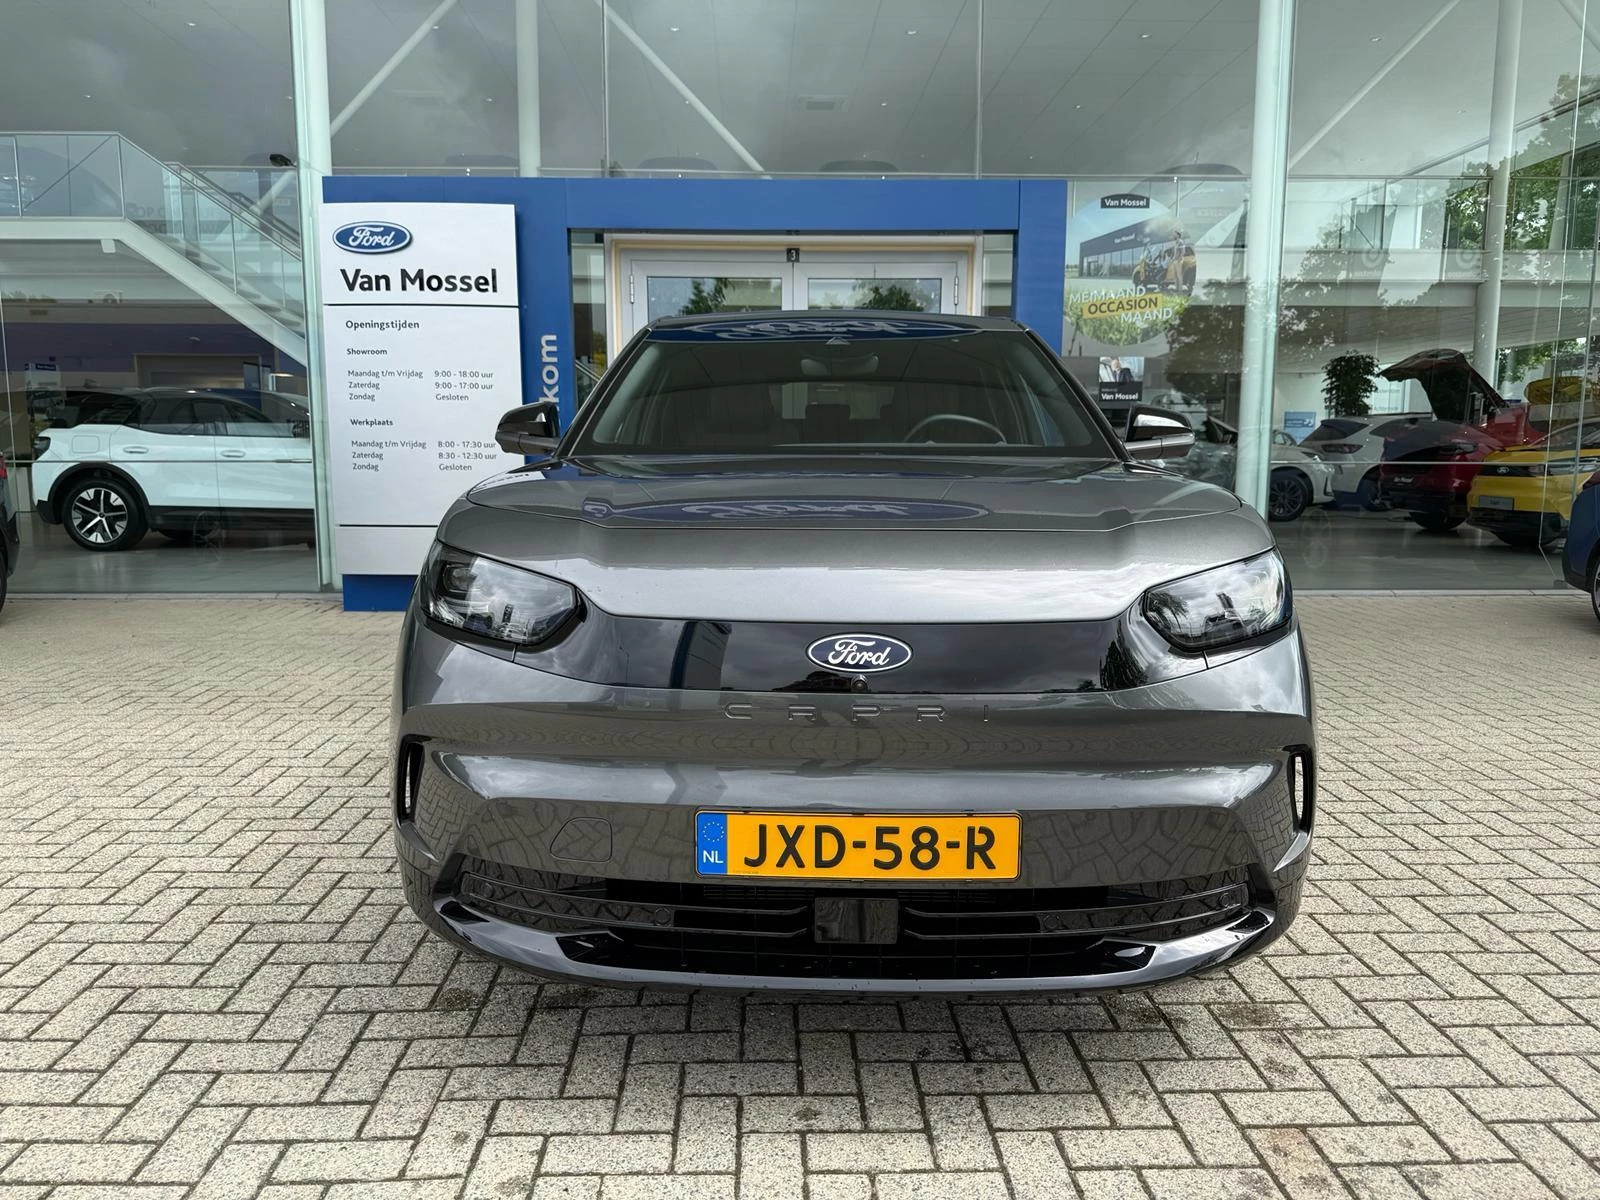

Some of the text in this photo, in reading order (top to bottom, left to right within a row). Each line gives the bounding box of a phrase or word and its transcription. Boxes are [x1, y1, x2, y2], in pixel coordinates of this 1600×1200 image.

[1104, 198, 1147, 206] Van Mossel
[348, 226, 396, 246] Ford
[790, 249, 796, 261] 3
[340, 268, 498, 293] Van Mossel
[1088, 297, 1158, 315] OCCASION
[1120, 307, 1173, 323] MAAND
[345, 319, 420, 332] Openingstijden
[346, 347, 388, 356] Showroom
[347, 369, 380, 379] Maandag
[381, 369, 396, 378] t/m
[396, 369, 424, 379] Vrijdag
[433, 370, 452, 378] 9:00
[458, 370, 480, 378] 18:00
[539, 334, 560, 404] kom
[348, 381, 381, 390] Zaterdag
[434, 381, 453, 390] 9:00
[458, 381, 480, 390] 17:00
[348, 392, 470, 402] Zondag Gesloten
[1115, 392, 1139, 400] Mossel
[350, 418, 394, 428] Werkplaats
[351, 440, 384, 449] Maandag
[385, 440, 399, 448] t/m
[400, 440, 427, 450] Vrijdag
[437, 440, 456, 449] 8:00
[461, 440, 482, 449] 17:30
[352, 451, 384, 461] Zaterdag
[438, 452, 456, 460] 8:30
[462, 452, 484, 460] 12:30
[352, 462, 473, 472] Zondag Gesloten
[827, 639, 892, 666] Ford
[721, 703, 990, 722] CAPRI
[743, 823, 997, 871] JXD-58-R
[702, 850, 724, 864] NL
